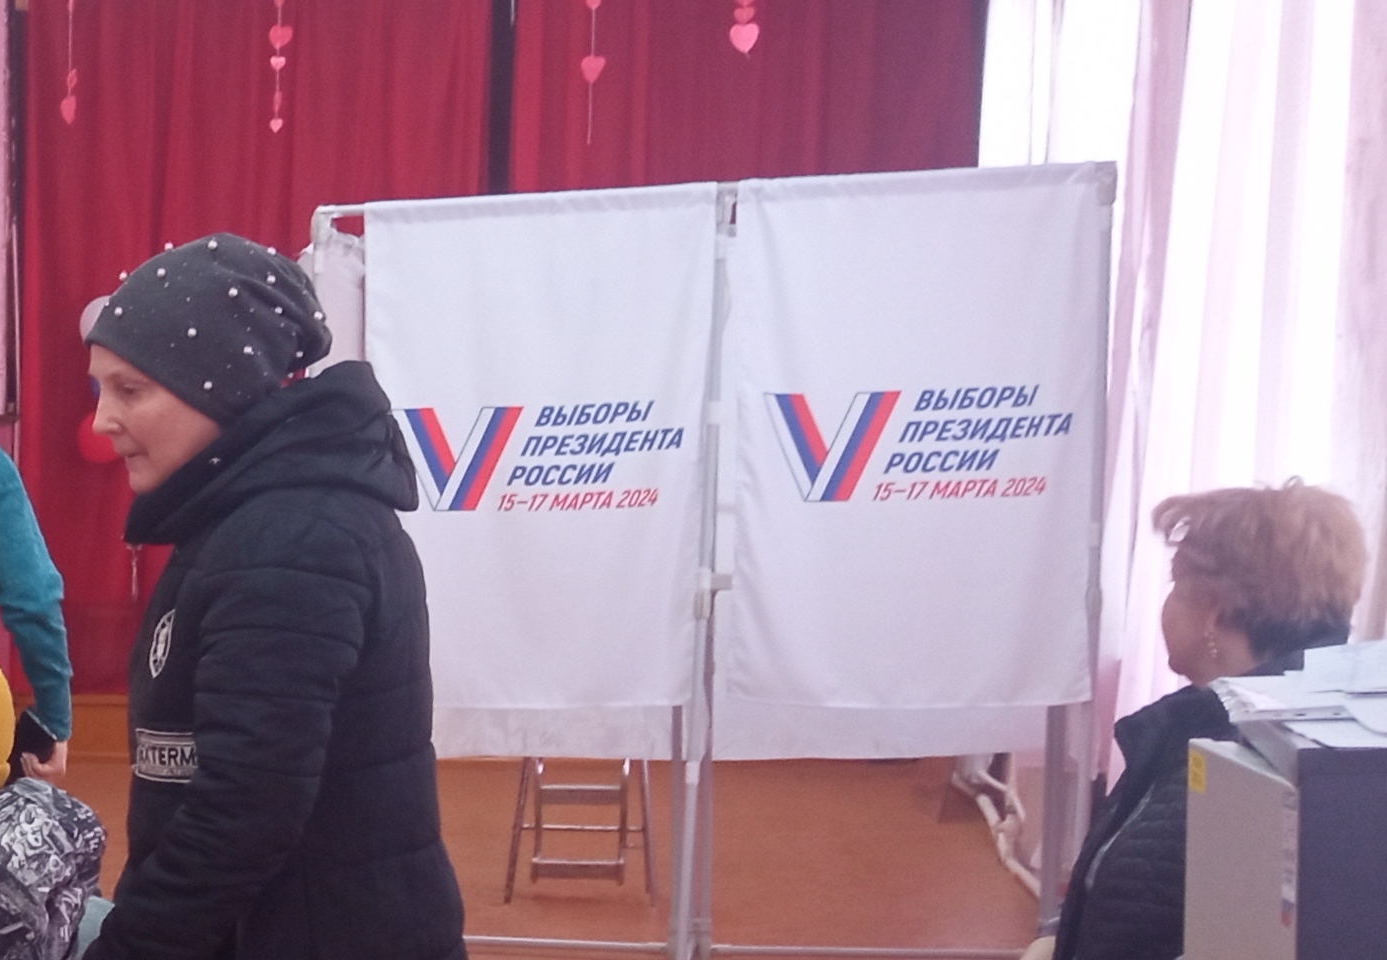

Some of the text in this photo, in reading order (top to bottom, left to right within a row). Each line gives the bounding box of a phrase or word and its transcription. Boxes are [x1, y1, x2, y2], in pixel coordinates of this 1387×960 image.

[914, 384, 1040, 411] ВЫБОРЫ
[535, 400, 654, 427] ВЫБОРЫ
[898, 412, 1073, 443] ПРЕЗИДЕНТА
[521, 427, 684, 457] ПРЕЗИДЕНТА
[507, 462, 615, 486] РОССИИ
[883, 449, 1000, 475] РОССИИ
[549, 491, 614, 511] МАРТА
[616, 488, 658, 508] 2024
[929, 479, 998, 500] МАРТА
[1001, 477, 1047, 497] 2024
